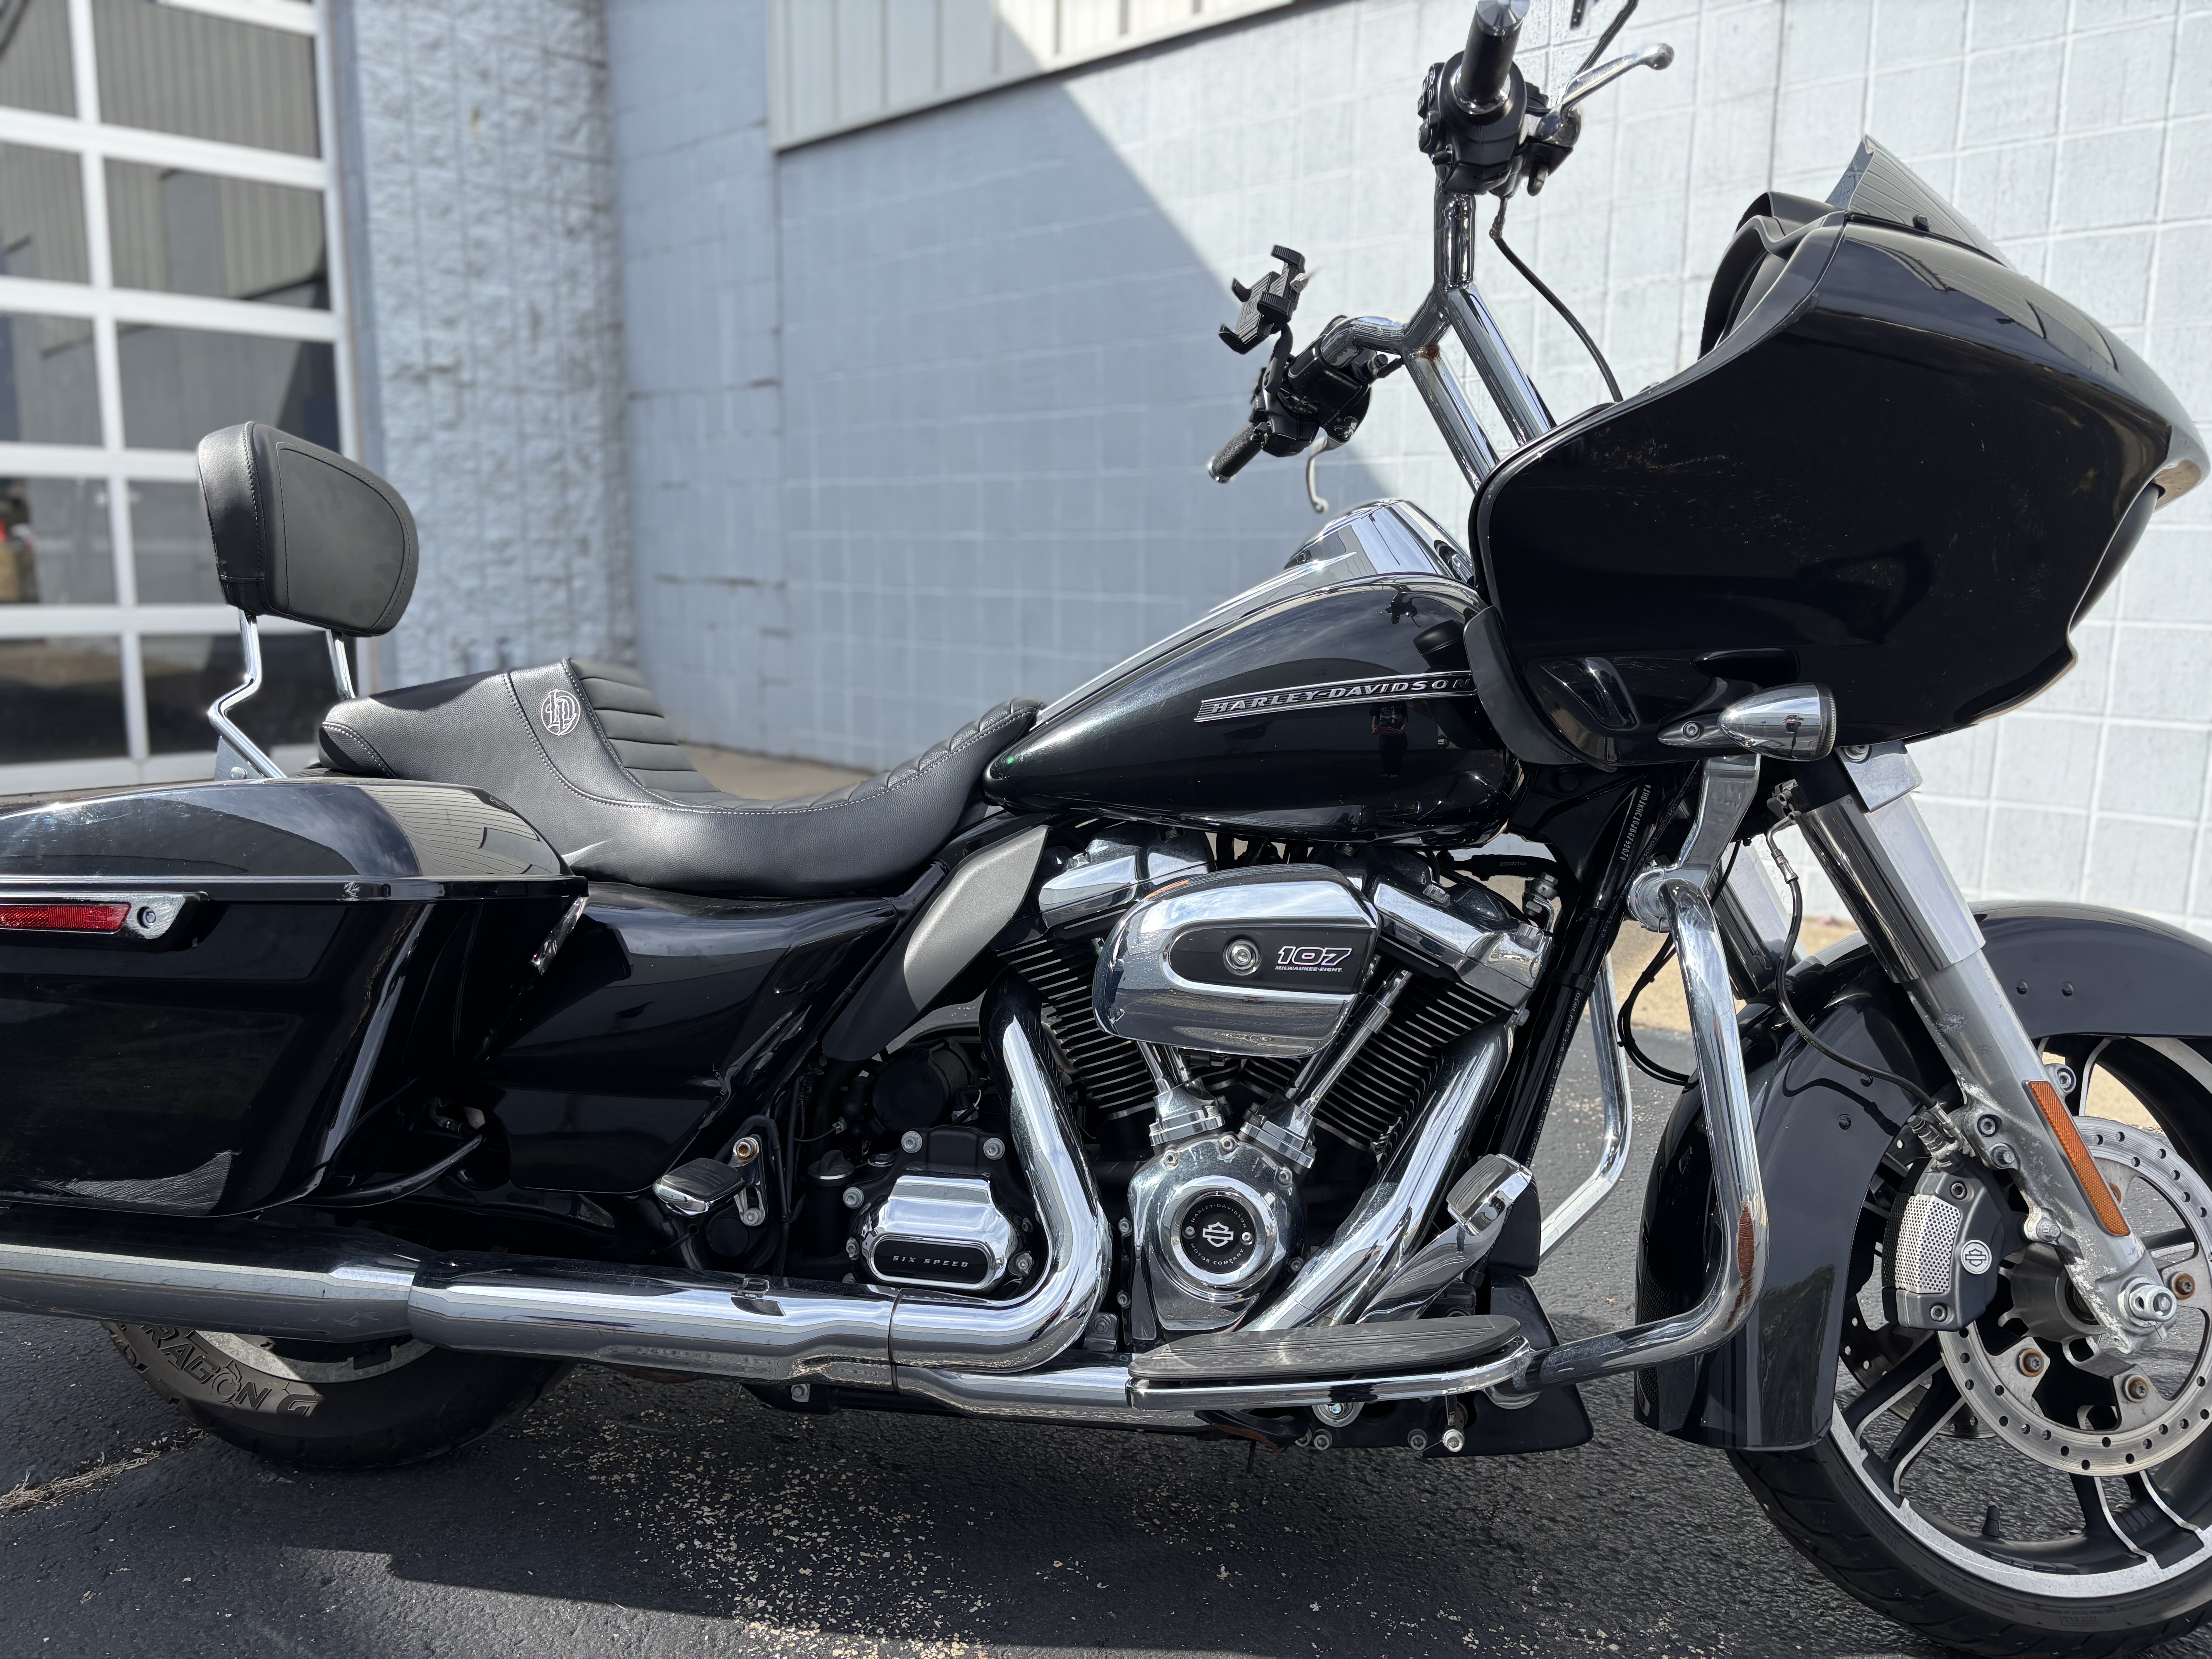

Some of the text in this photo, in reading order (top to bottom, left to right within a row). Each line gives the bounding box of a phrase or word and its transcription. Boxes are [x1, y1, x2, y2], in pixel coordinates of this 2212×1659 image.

[1211, 678, 1471, 713] HARLEY-DAVIDSON
[1277, 946, 1352, 966] 107
[1191, 1204, 1247, 1228] HARLEY-DAVIDSON
[924, 1259, 969, 1267] SPEED
[1190, 1243, 1244, 1265] MOTOR COMPANY
